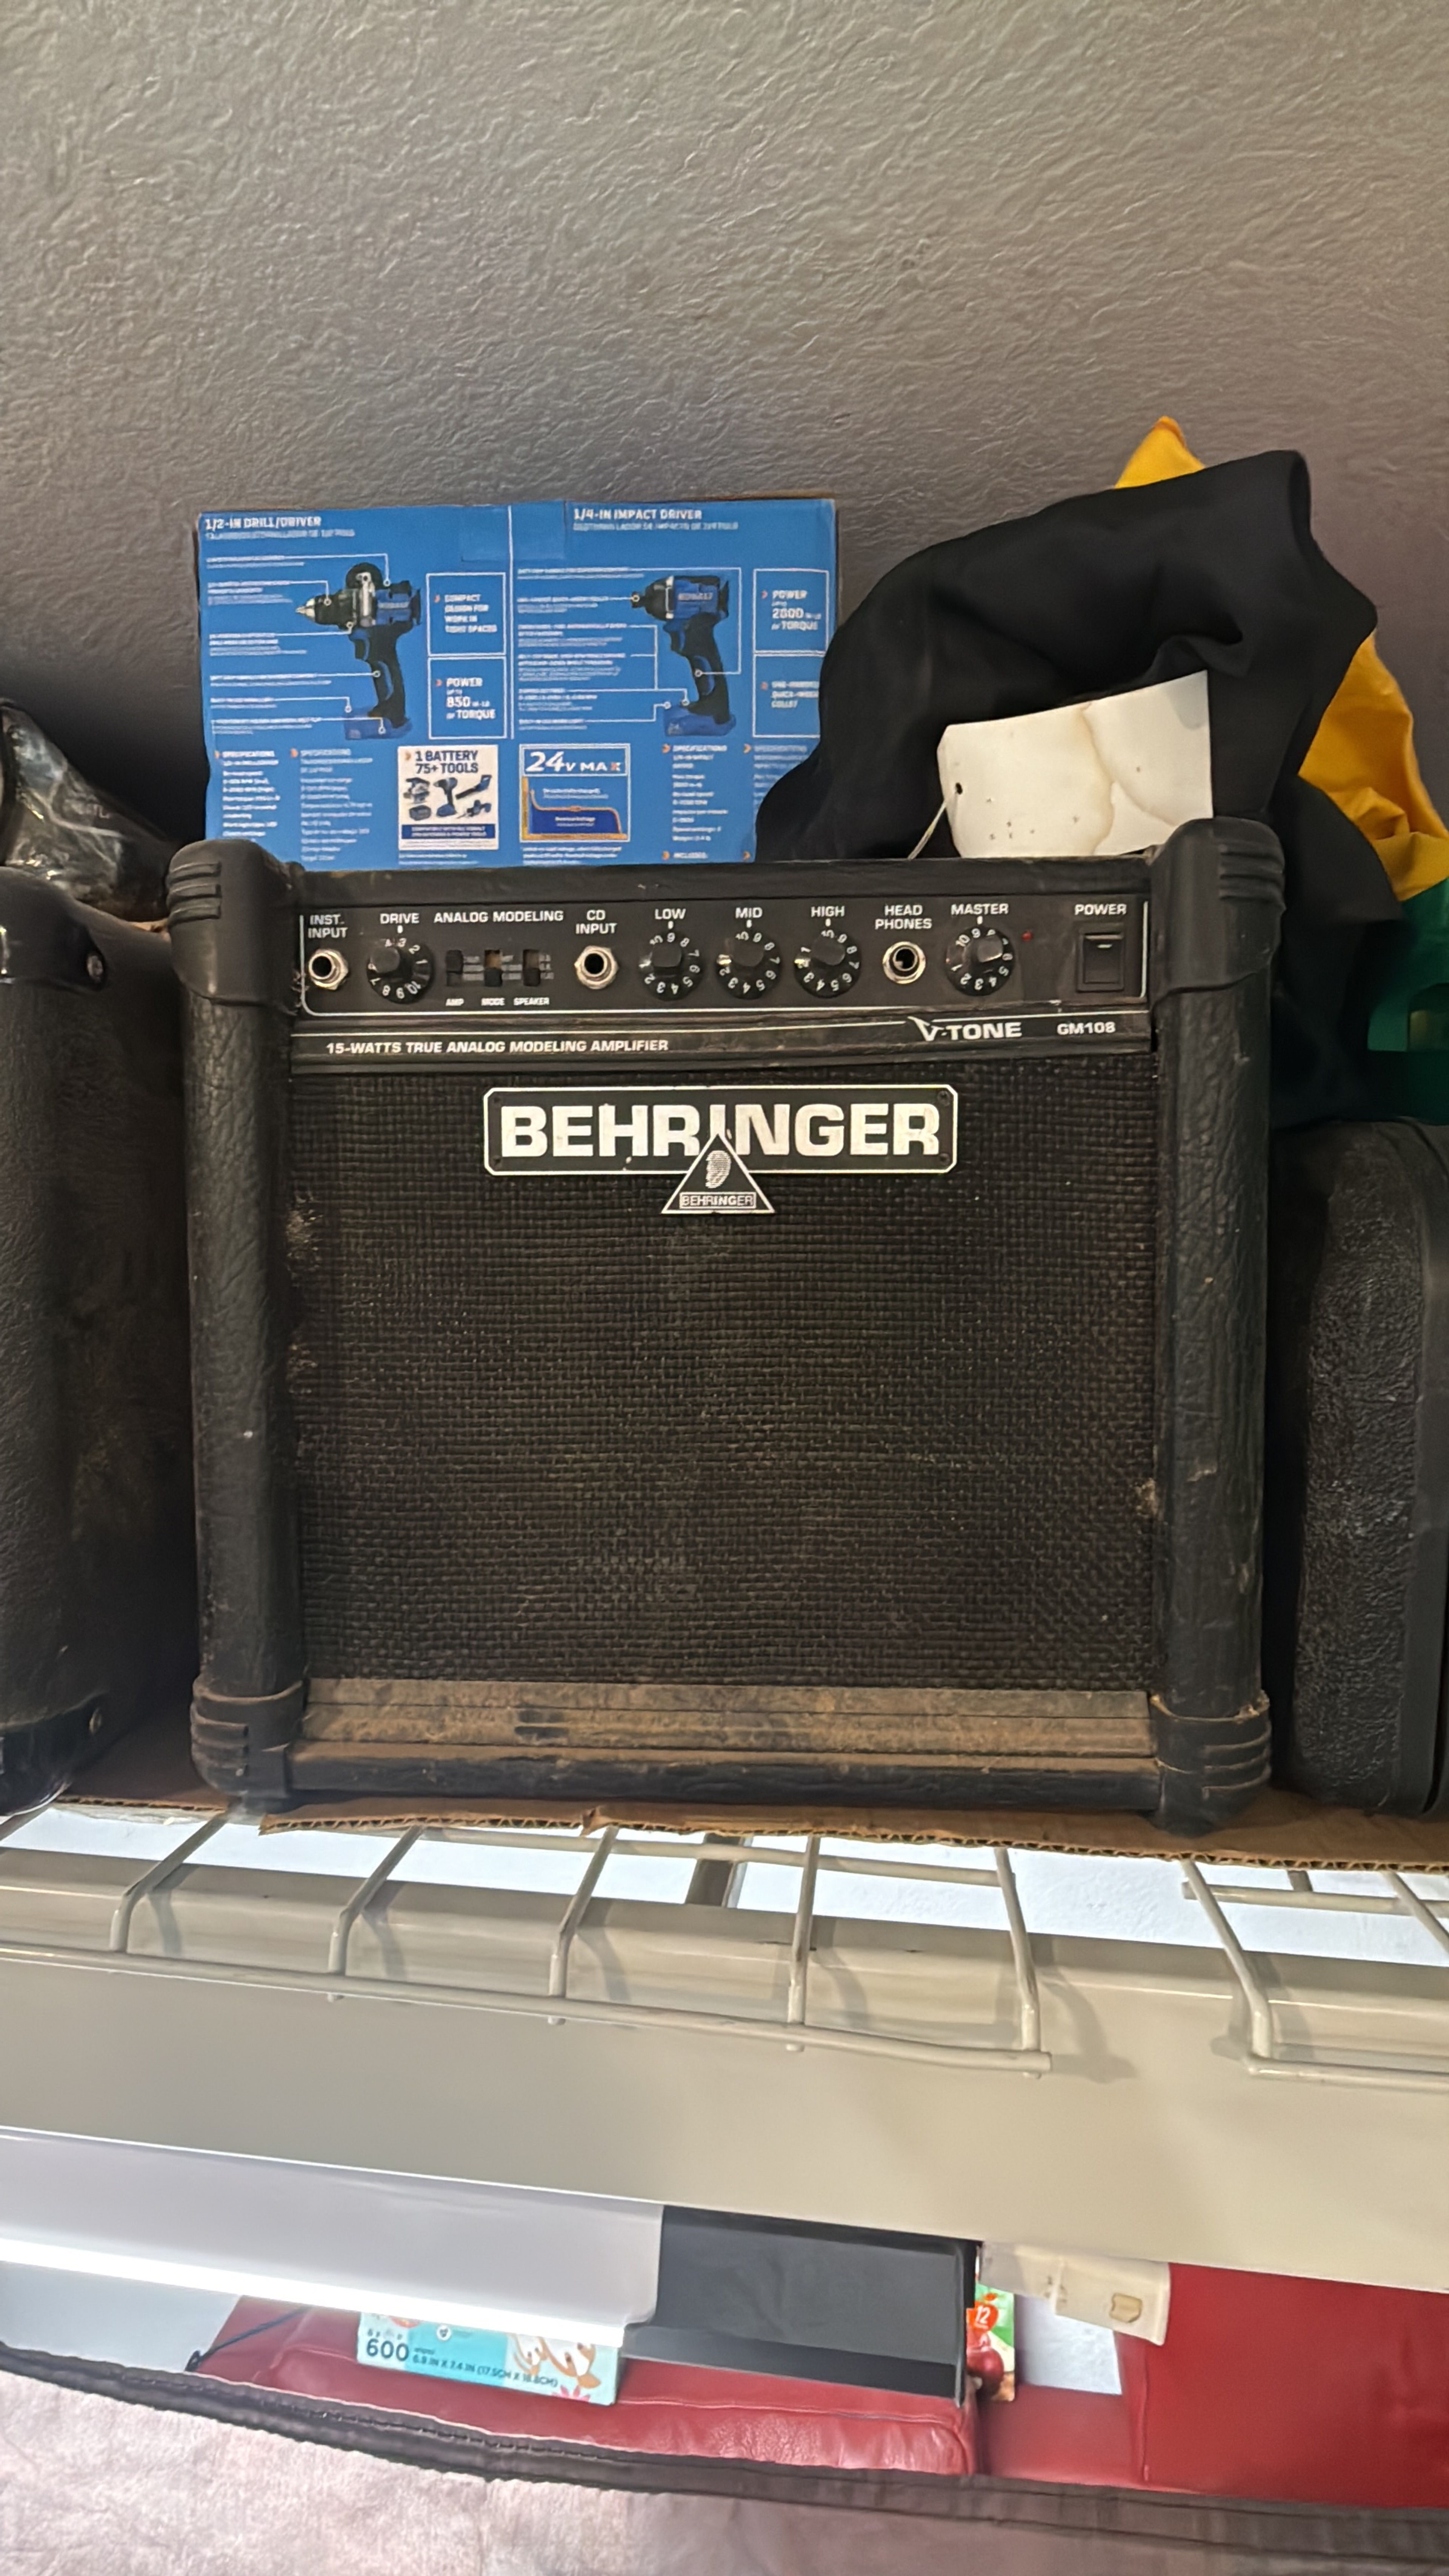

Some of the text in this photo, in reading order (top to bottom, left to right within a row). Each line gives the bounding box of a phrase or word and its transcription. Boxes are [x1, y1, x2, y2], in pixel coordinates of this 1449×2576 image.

[574, 509, 702, 521] 1/4-IN IMPACT DRIVER
[205, 516, 322, 531] 1/2-IN DRILL/DRIVER
[772, 590, 807, 599] POWER
[781, 621, 818, 631] TORQUE
[446, 678, 483, 687] POWER
[446, 696, 471, 707] 850
[456, 709, 495, 720] TORQUE
[415, 750, 478, 761] 1 BATTERY
[416, 763, 478, 774] 75+ TOOLS
[586, 909, 606, 921] CD
[655, 908, 686, 920] LOW
[735, 907, 763, 919] MID
[811, 906, 845, 918] HIGH
[884, 905, 923, 916] HEAD
[951, 903, 1009, 915] MASTER
[1075, 904, 1127, 916] POWER
[310, 914, 345, 925] INST.
[380, 913, 420, 924] DRIVE
[434, 910, 564, 923] ANALOG MODELING
[575, 923, 617, 934] INPUT
[875, 918, 932, 930] PHONES
[308, 927, 348, 938] INPUT
[971, 928, 981, 938] 9
[680, 937, 690, 947] 8
[955, 934, 971, 947] 10
[409, 944, 420, 954] 2
[682, 976, 694, 987] 5
[842, 973, 852, 983] 6
[974, 978, 984, 990] 3
[382, 984, 391, 997] 8
[657, 981, 666, 993] 3
[671, 983, 679, 995] 4
[756, 979, 766, 991] 5
[831, 980, 840, 992] 5
[446, 998, 464, 1006] AMP
[481, 998, 505, 1006] MODE
[514, 997, 549, 1006] SPEAKER
[908, 1016, 1022, 1041] V-TONE
[1057, 1021, 1115, 1035] GM108
[326, 1040, 668, 1055] 15-WATTS TRUE ANALOG MODELING AMPLIFIER
[501, 1103, 940, 1157] BEHRINGER
[682, 1195, 754, 1206] BEHRINGER
[975, 2305, 991, 2324] 12
[366, 2338, 409, 2361] 600
